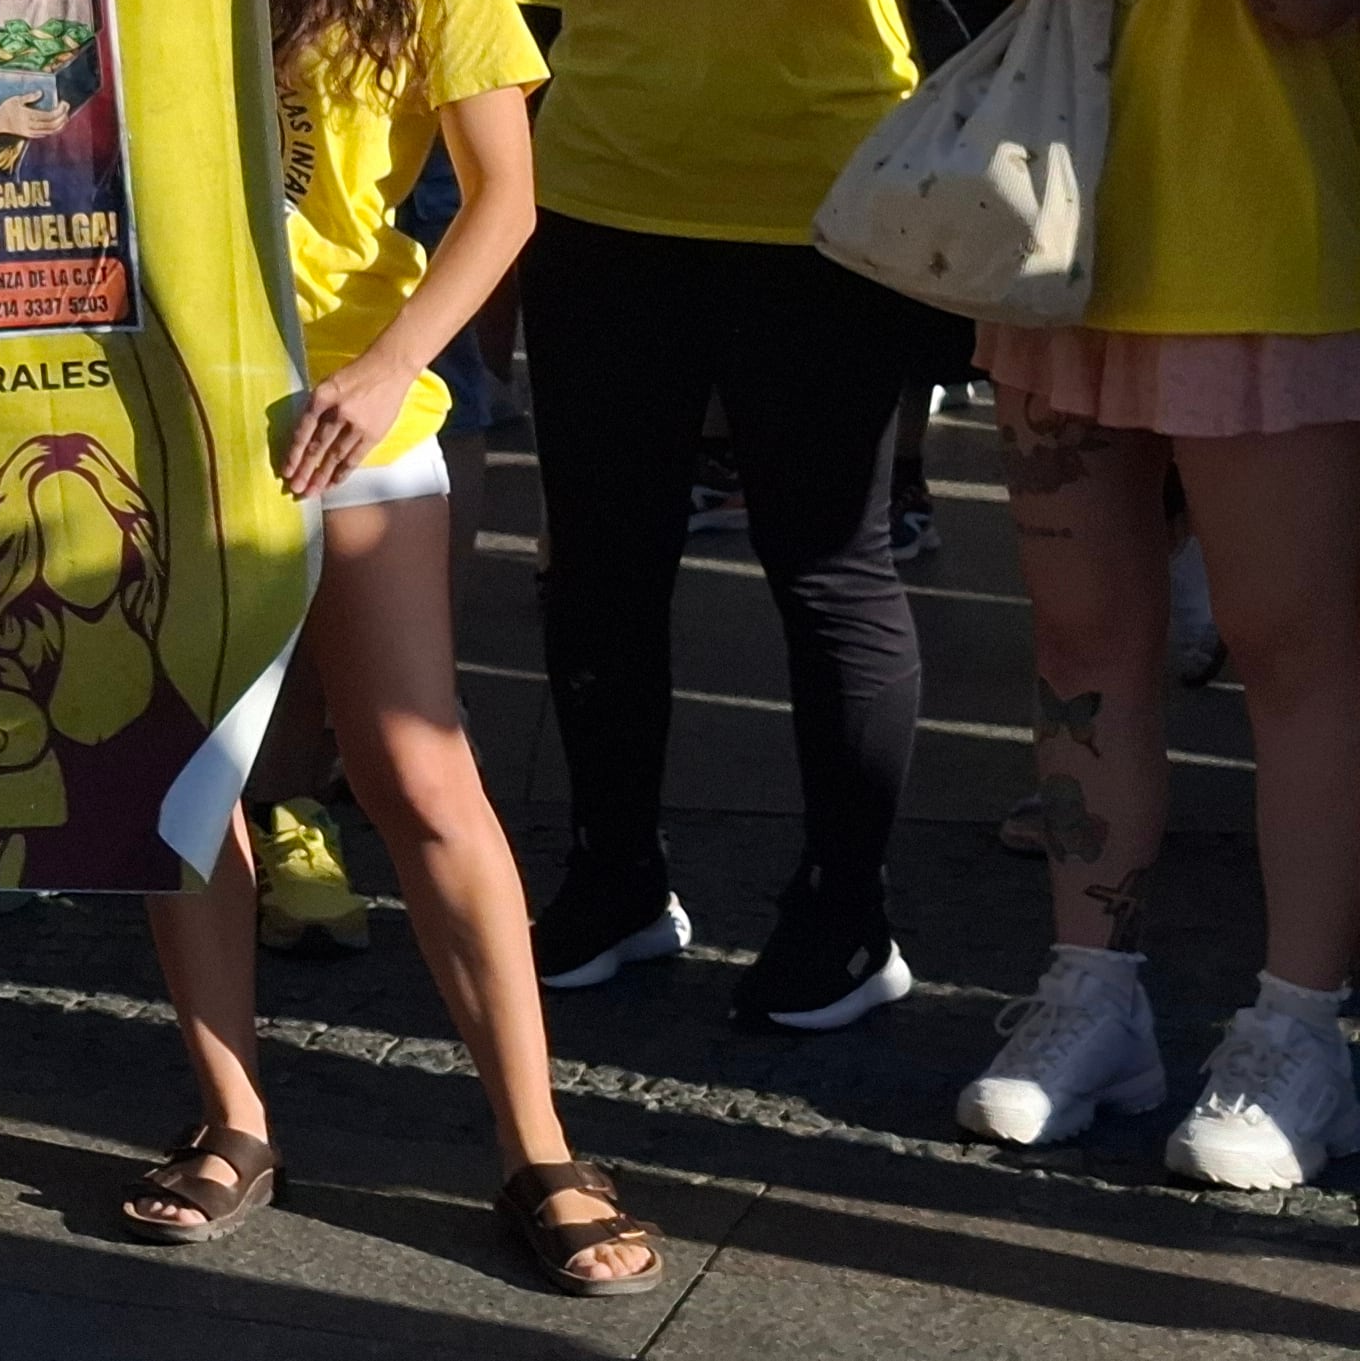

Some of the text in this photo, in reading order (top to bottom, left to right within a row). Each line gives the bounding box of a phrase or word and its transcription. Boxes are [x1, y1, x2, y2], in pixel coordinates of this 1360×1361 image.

[4, 210, 118, 253] HUELGA!
[29, 268, 48, 287] DE
[51, 268, 68, 287] LA
[24, 297, 63, 317] 3337
[68, 294, 109, 315] 5203
